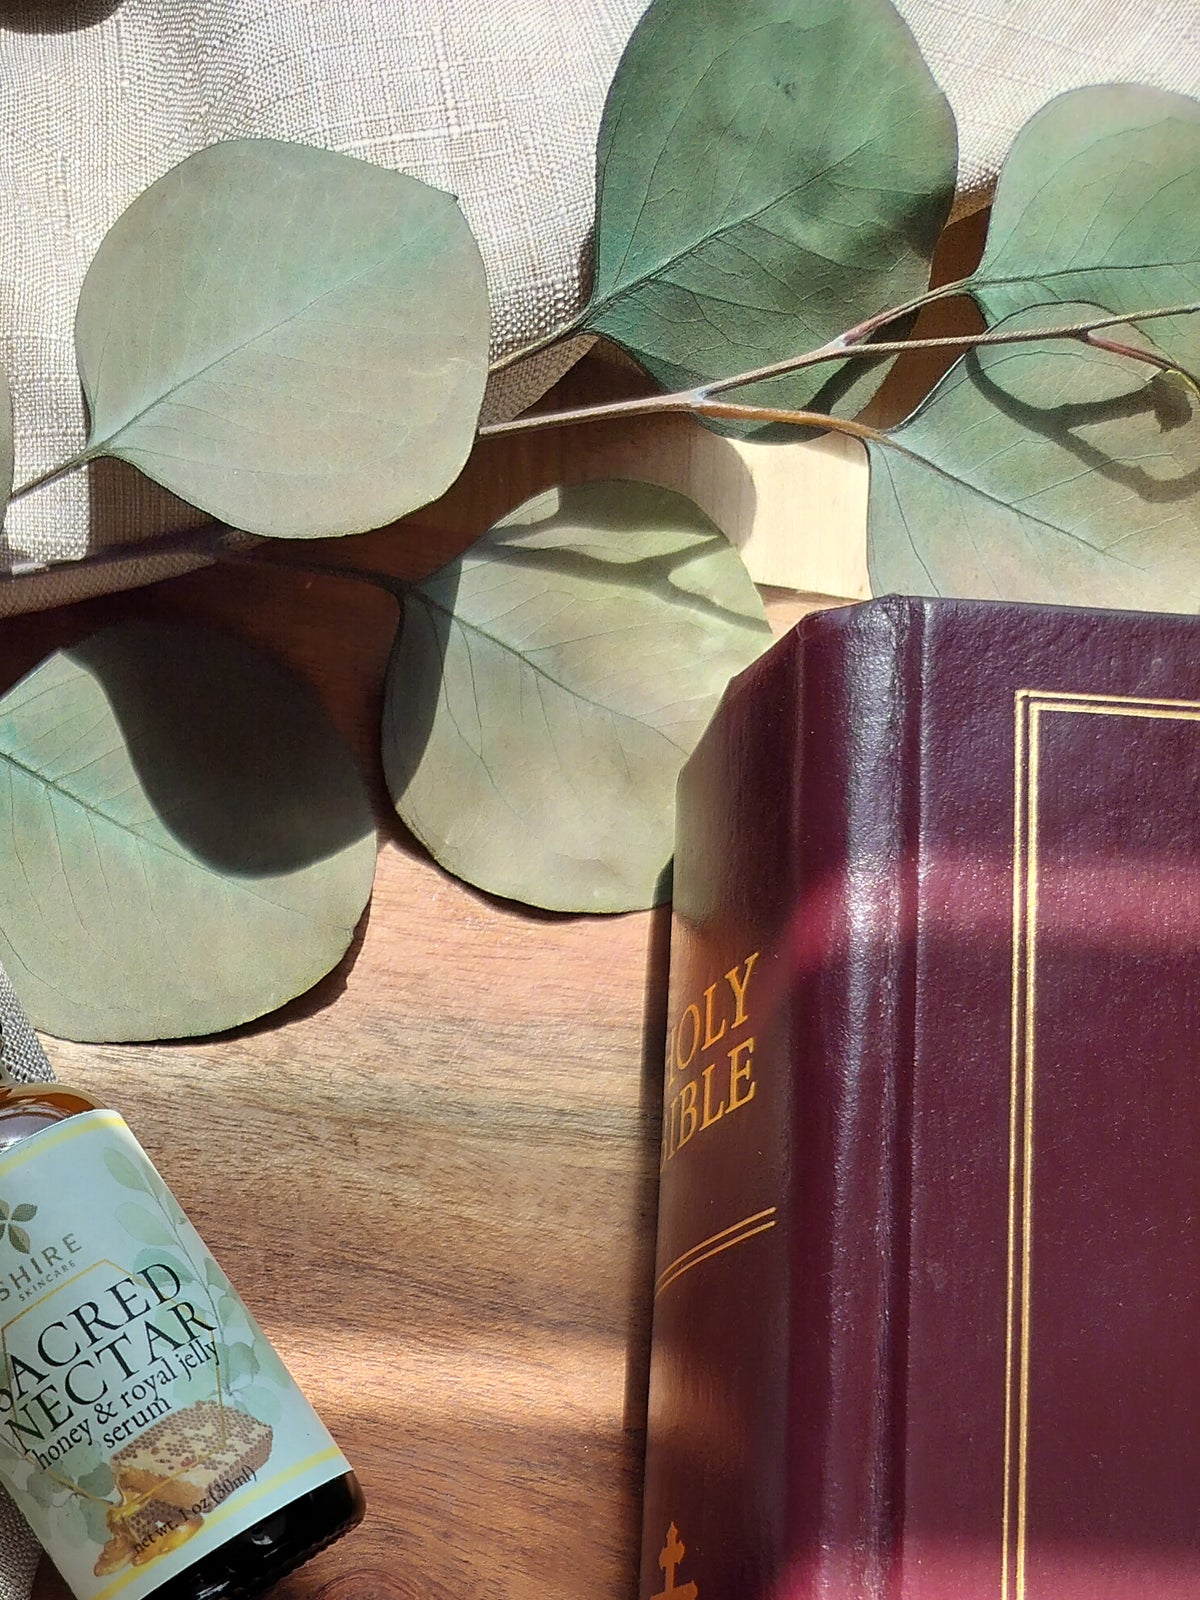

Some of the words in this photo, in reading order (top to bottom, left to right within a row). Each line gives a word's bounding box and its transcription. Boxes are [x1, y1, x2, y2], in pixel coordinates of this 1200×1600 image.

[18, 1260, 76, 1302] SKINCARE
[4, 1301, 218, 1455] NECTAR
[31, 1418, 94, 1470] honey
[93, 1400, 118, 1425] &
[120, 1358, 178, 1409] royal
[174, 1338, 220, 1382] jelly
[102, 1396, 173, 1449] serum
[133, 1532, 156, 1555] net
[156, 1518, 179, 1538] wt.
[178, 1508, 189, 1522] 1
[191, 1499, 211, 1515] oz
[208, 1464, 258, 1508] (30ml)
